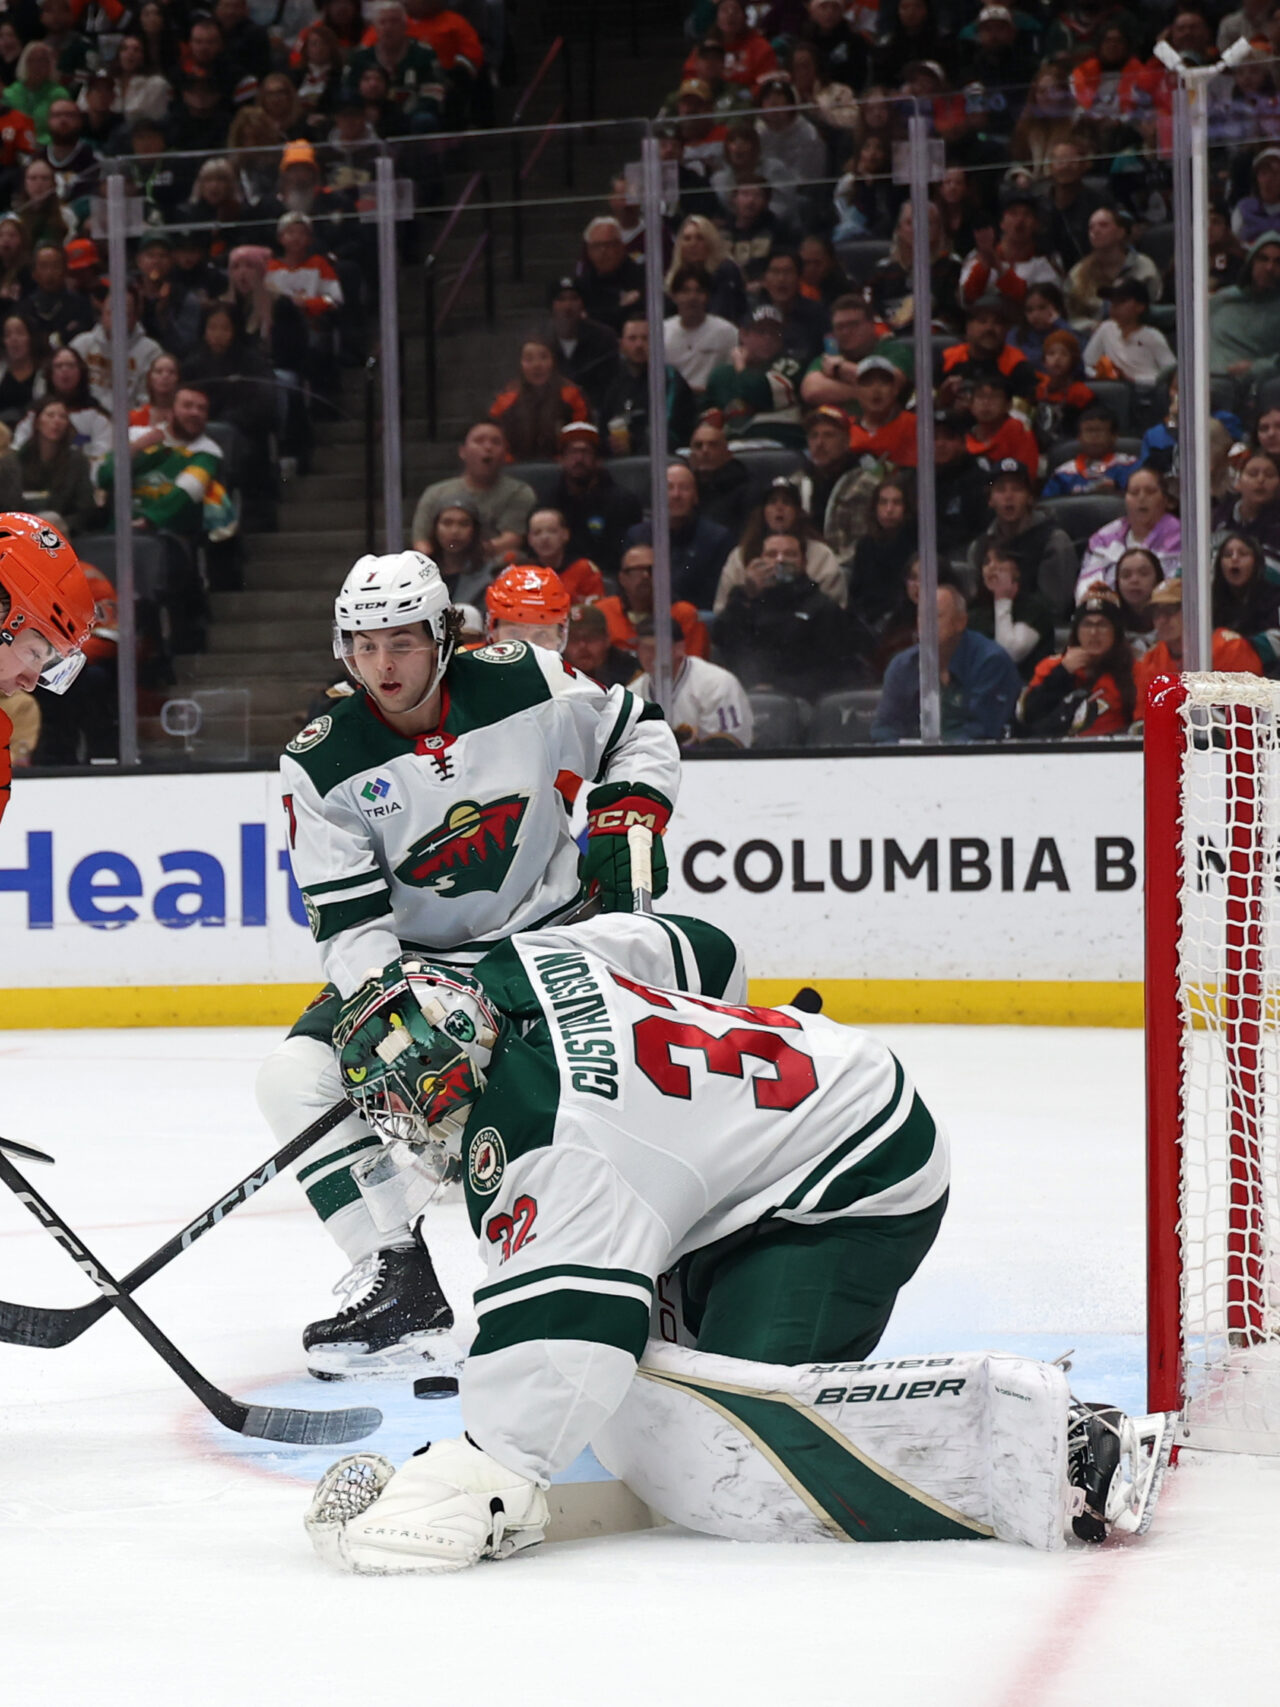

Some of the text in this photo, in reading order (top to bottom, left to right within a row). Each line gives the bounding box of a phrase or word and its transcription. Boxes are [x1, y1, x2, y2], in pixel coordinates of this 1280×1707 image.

[354, 601, 387, 611] CCM
[363, 800, 402, 819] TRIA
[682, 836, 1070, 893] COLUMBIA
[485, 1166, 503, 1189] WILD
[182, 1160, 277, 1250] CCM
[17, 1191, 120, 1297] CCM
[814, 1378, 967, 1405] BAUER
[363, 1527, 456, 1547] CATALYST
